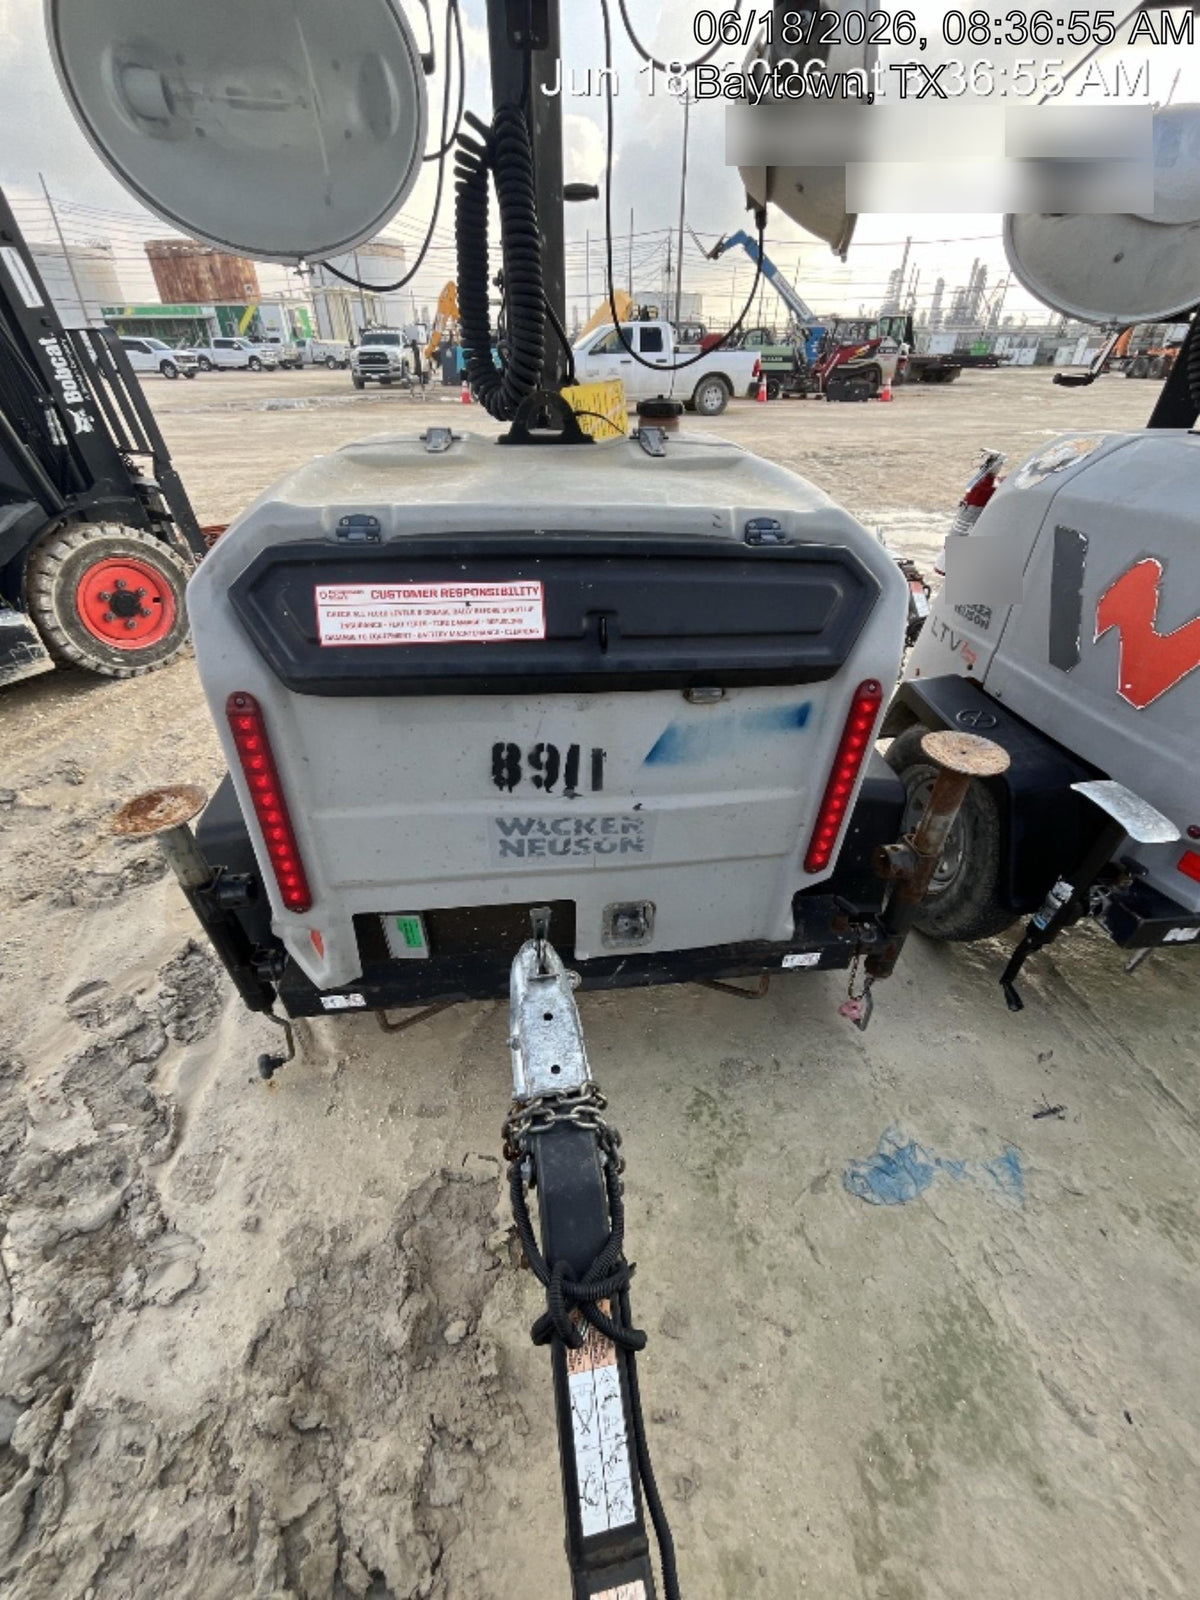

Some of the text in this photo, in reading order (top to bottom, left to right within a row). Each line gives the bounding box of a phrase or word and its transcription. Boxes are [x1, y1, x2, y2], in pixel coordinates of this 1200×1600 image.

[38, 336, 84, 404] Bobcat
[371, 588, 437, 600] CUSTOMER
[440, 586, 539, 598] RESPONSIBILITY
[492, 742, 604, 794] 8911
[495, 817, 644, 836] WACKER
[499, 836, 645, 858] NEUSON
